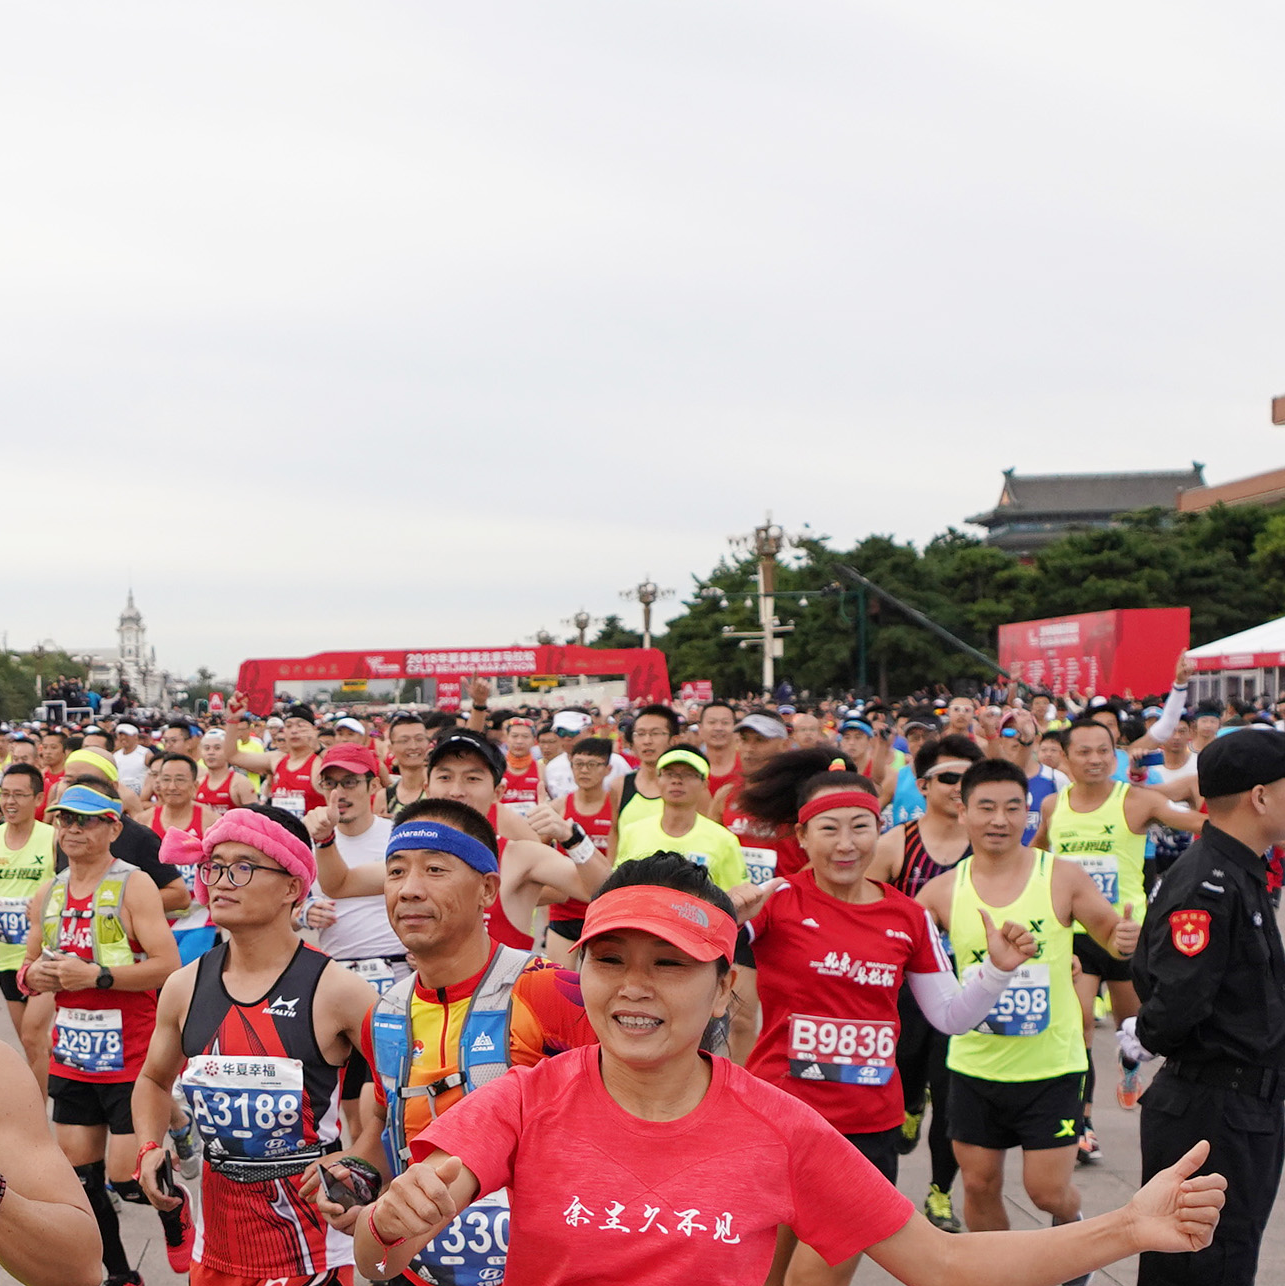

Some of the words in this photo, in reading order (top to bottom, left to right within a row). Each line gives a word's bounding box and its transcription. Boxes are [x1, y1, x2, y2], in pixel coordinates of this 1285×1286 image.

[262, 1007, 297, 1018] HEALTH
[57, 1027, 121, 1054] A2978
[792, 1019, 895, 1058] B9836
[222, 1062, 276, 1077] 华夏幸福
[192, 1089, 299, 1130] A3188
